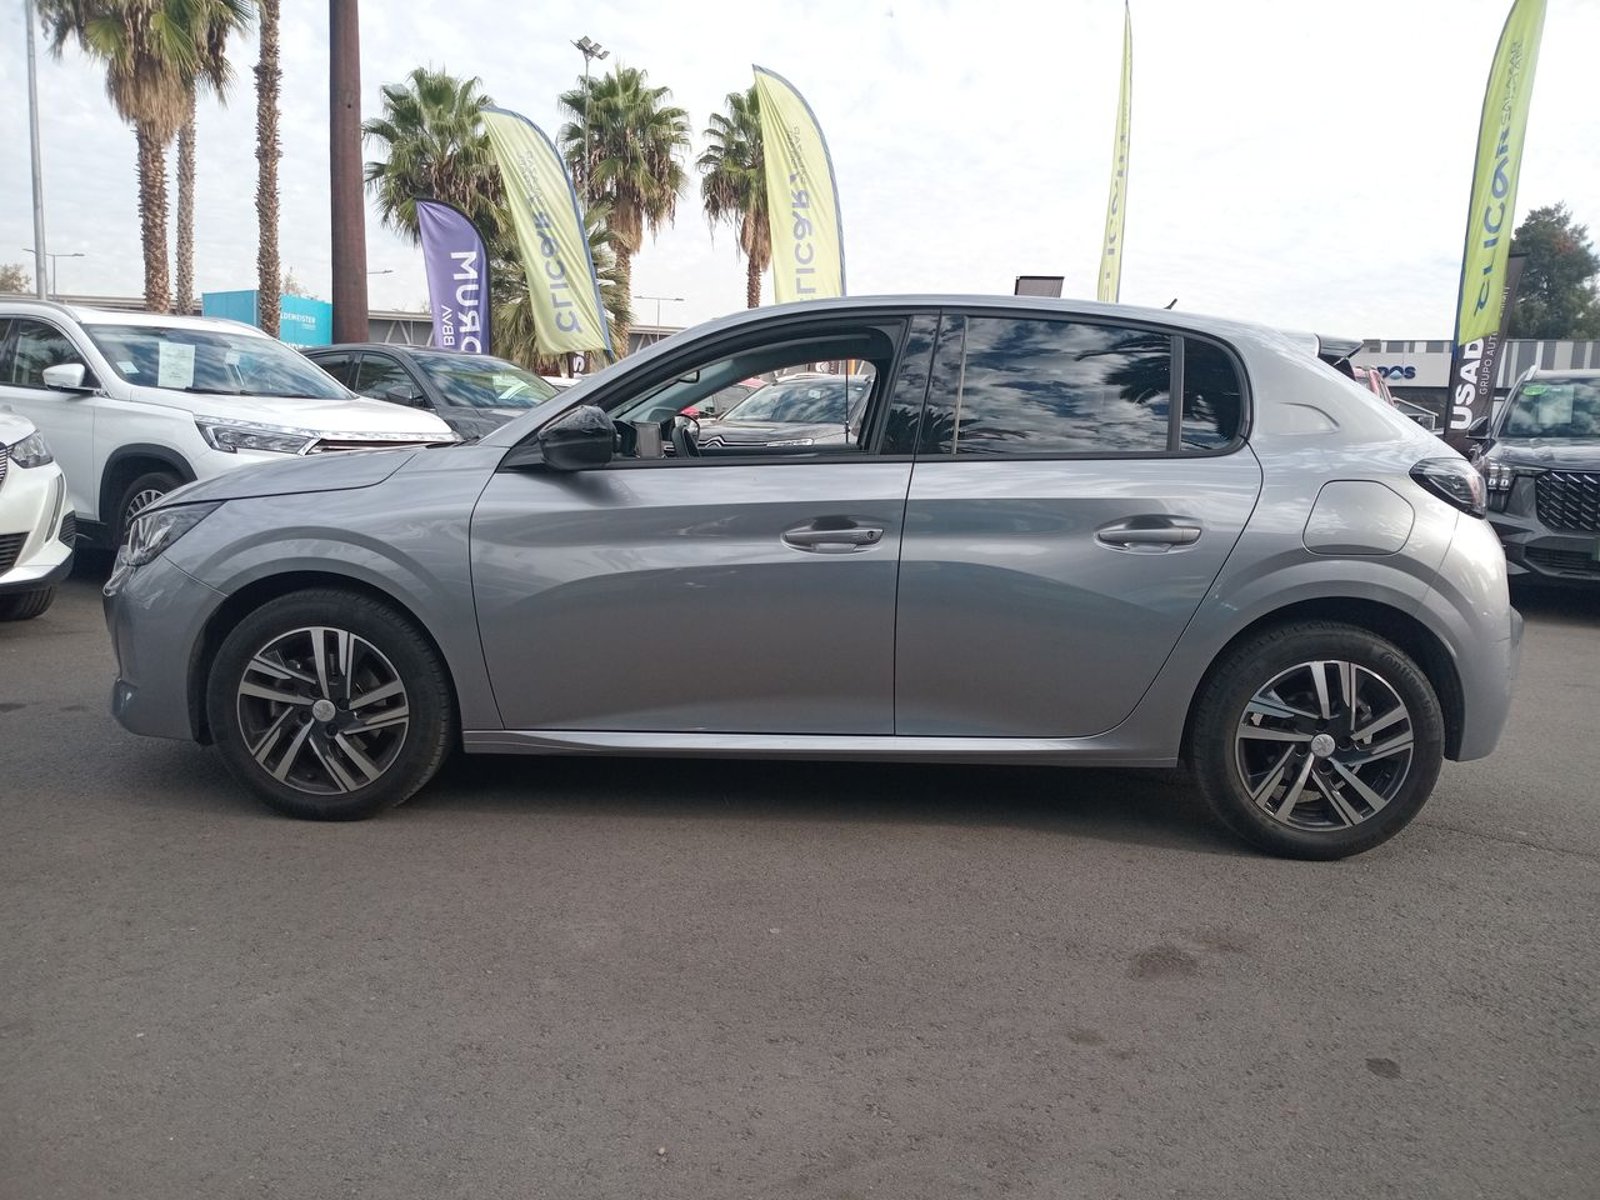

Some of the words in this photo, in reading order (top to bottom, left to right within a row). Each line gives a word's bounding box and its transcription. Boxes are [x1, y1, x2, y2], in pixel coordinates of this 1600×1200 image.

[1377, 366, 1416, 380] DOS
[1450, 337, 1485, 430] USAD
[1479, 358, 1492, 395] GRUPO
